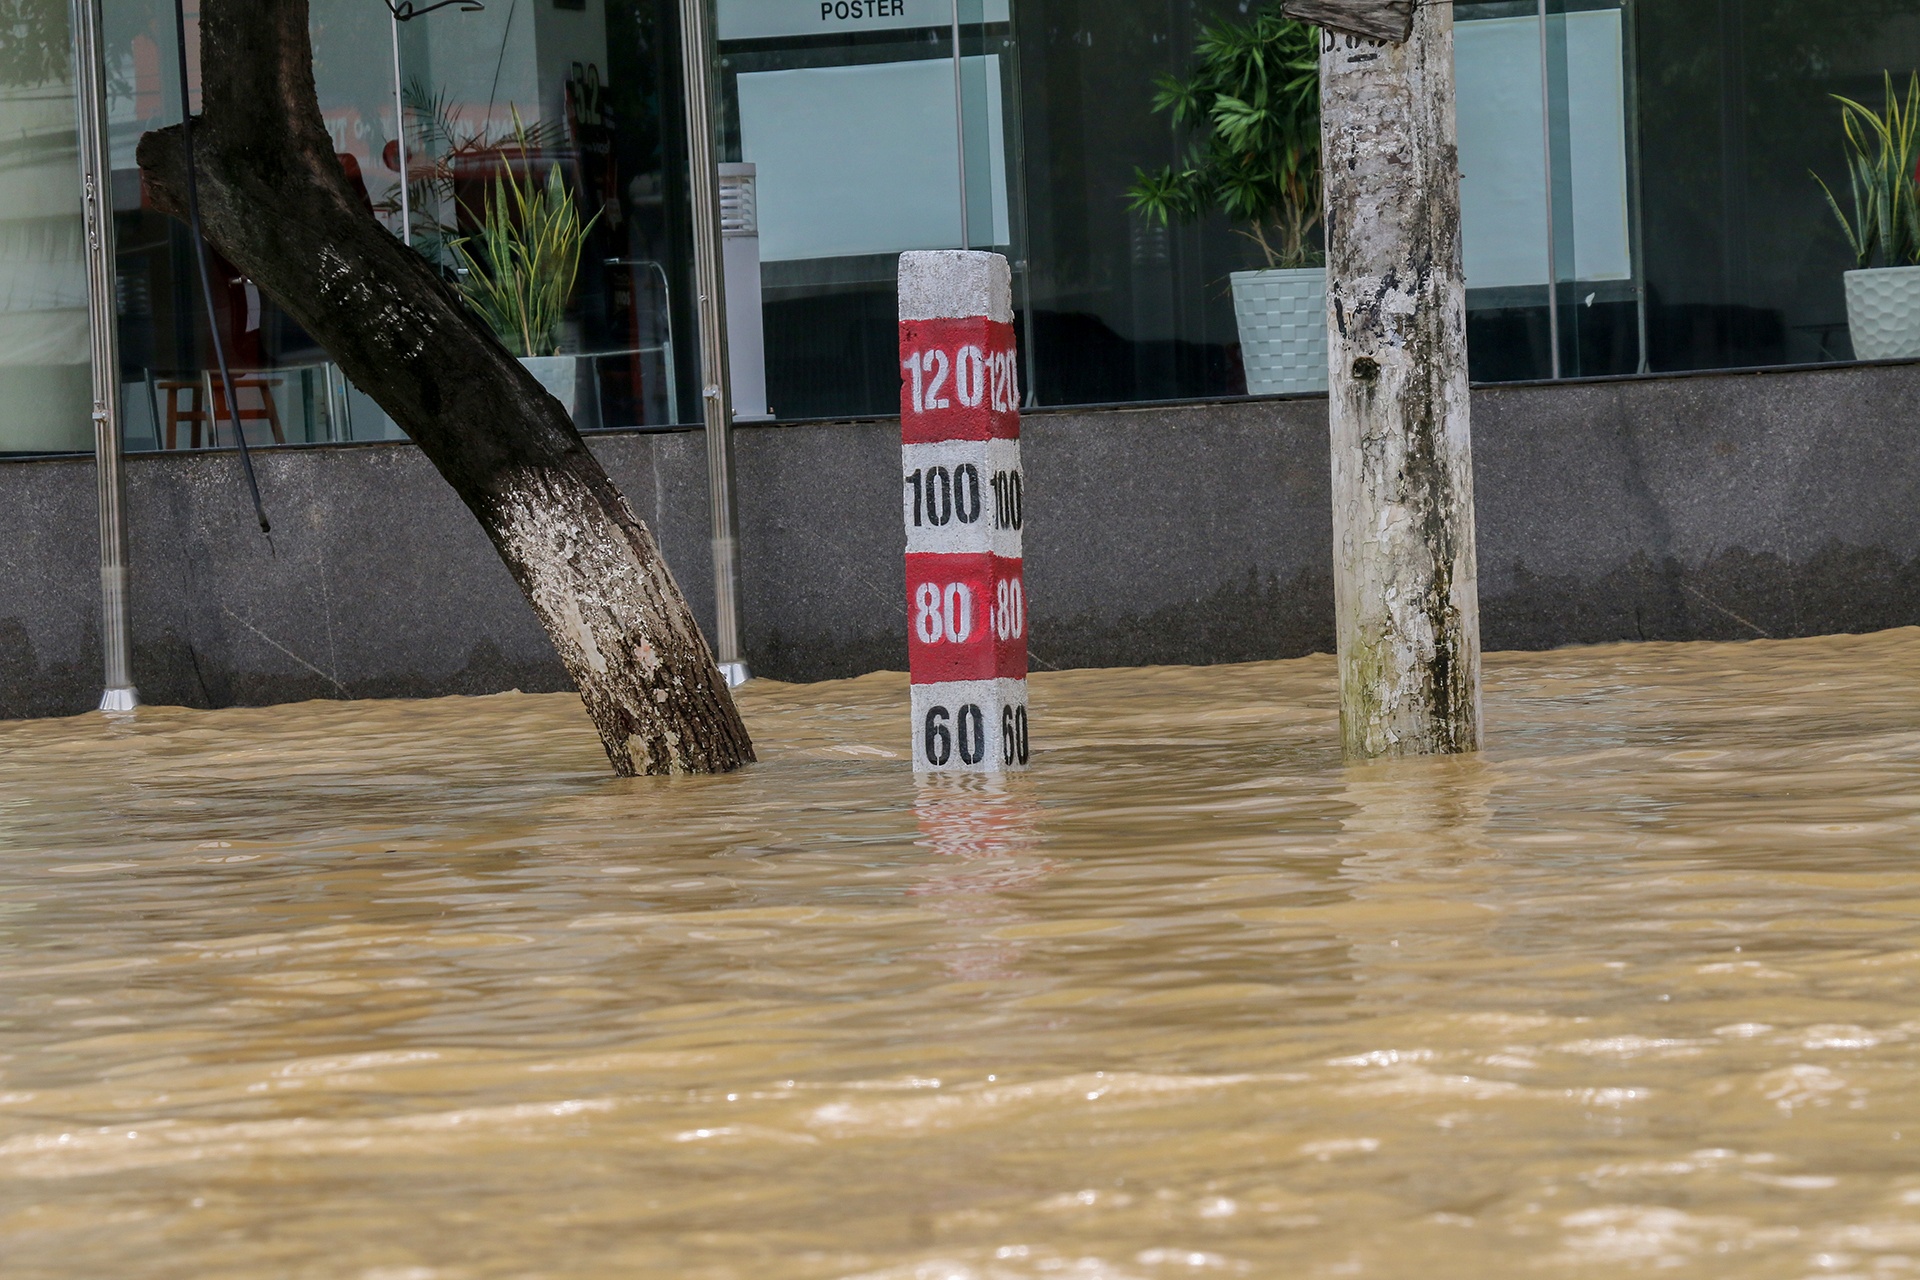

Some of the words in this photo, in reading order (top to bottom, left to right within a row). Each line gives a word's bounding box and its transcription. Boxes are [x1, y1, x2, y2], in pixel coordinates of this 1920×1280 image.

[821, 0, 904, 20] POSTER
[903, 345, 984, 414] 120
[985, 348, 1019, 413] 120
[905, 463, 981, 527] 100
[990, 469, 1021, 531] 100
[916, 582, 971, 643] 80
[997, 578, 1022, 641] 80
[925, 704, 984, 766] 60
[1002, 703, 1028, 766] 60
